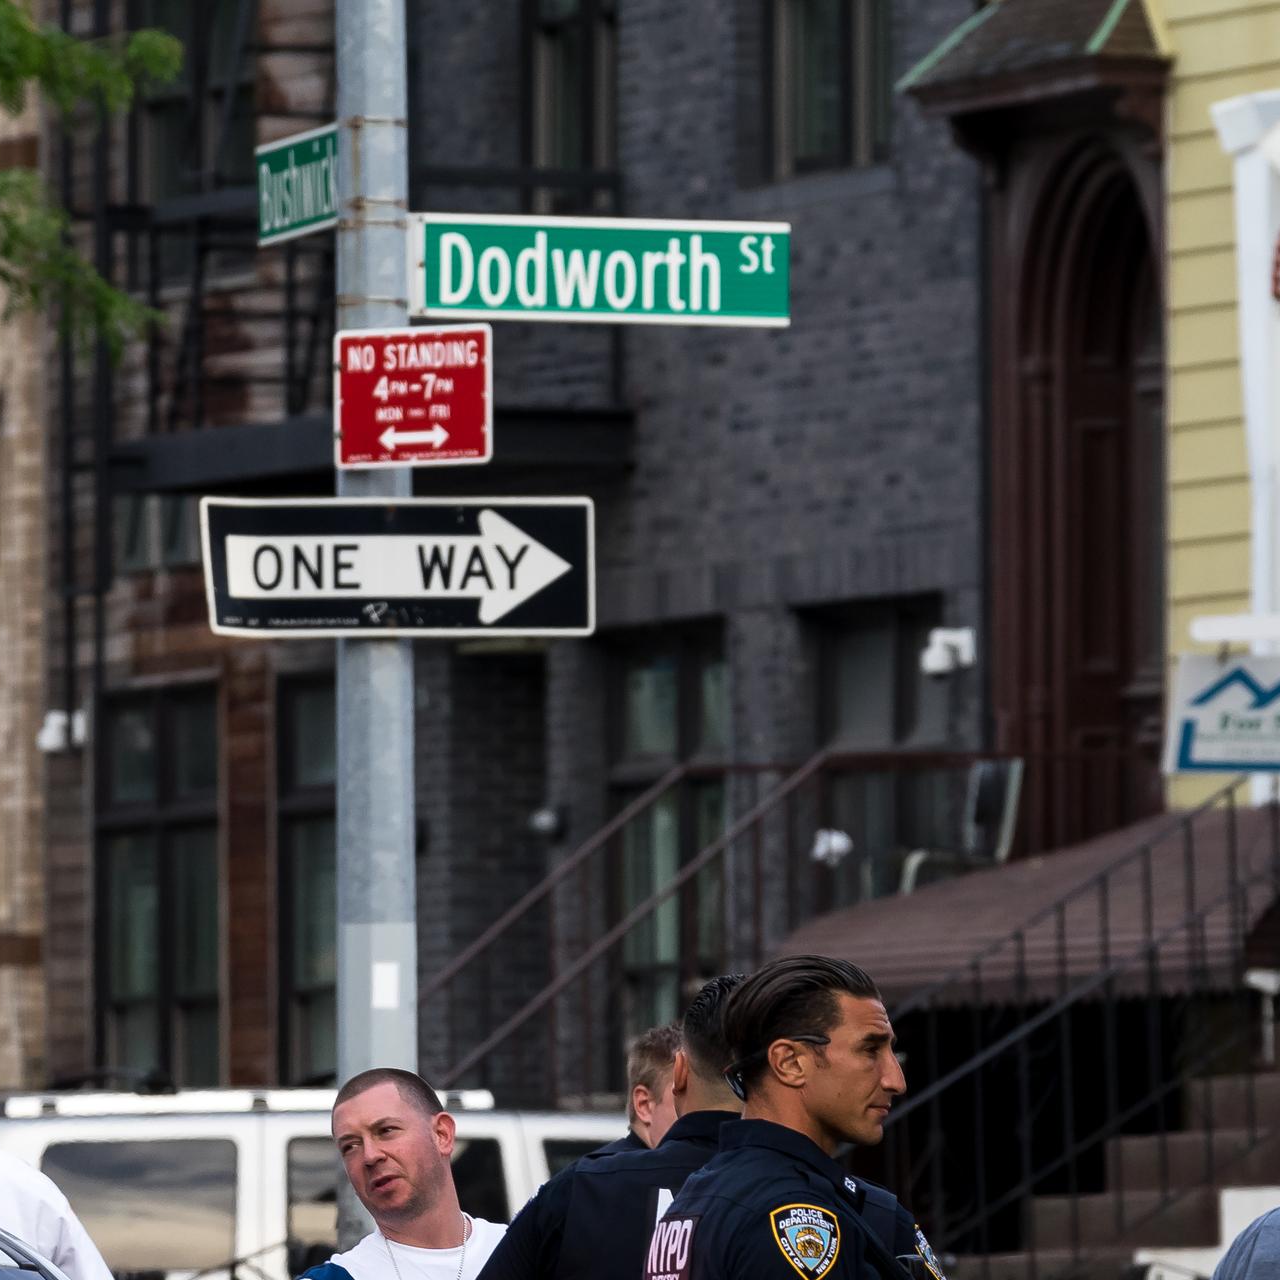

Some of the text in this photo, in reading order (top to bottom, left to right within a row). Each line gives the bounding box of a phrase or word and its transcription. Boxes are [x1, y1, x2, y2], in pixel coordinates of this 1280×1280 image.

[439, 229, 776, 312] Dodworth St
[347, 340, 478, 372] NO STANDING
[375, 406, 404, 422] MON
[253, 544, 529, 591] ONE WAY
[779, 1216, 835, 1232] DEPARTMENT
[790, 1208, 823, 1219] POLICE
[647, 1219, 694, 1274] NYPD
[780, 1237, 805, 1270] CITY OF
[816, 1237, 838, 1275] NEW YORK
